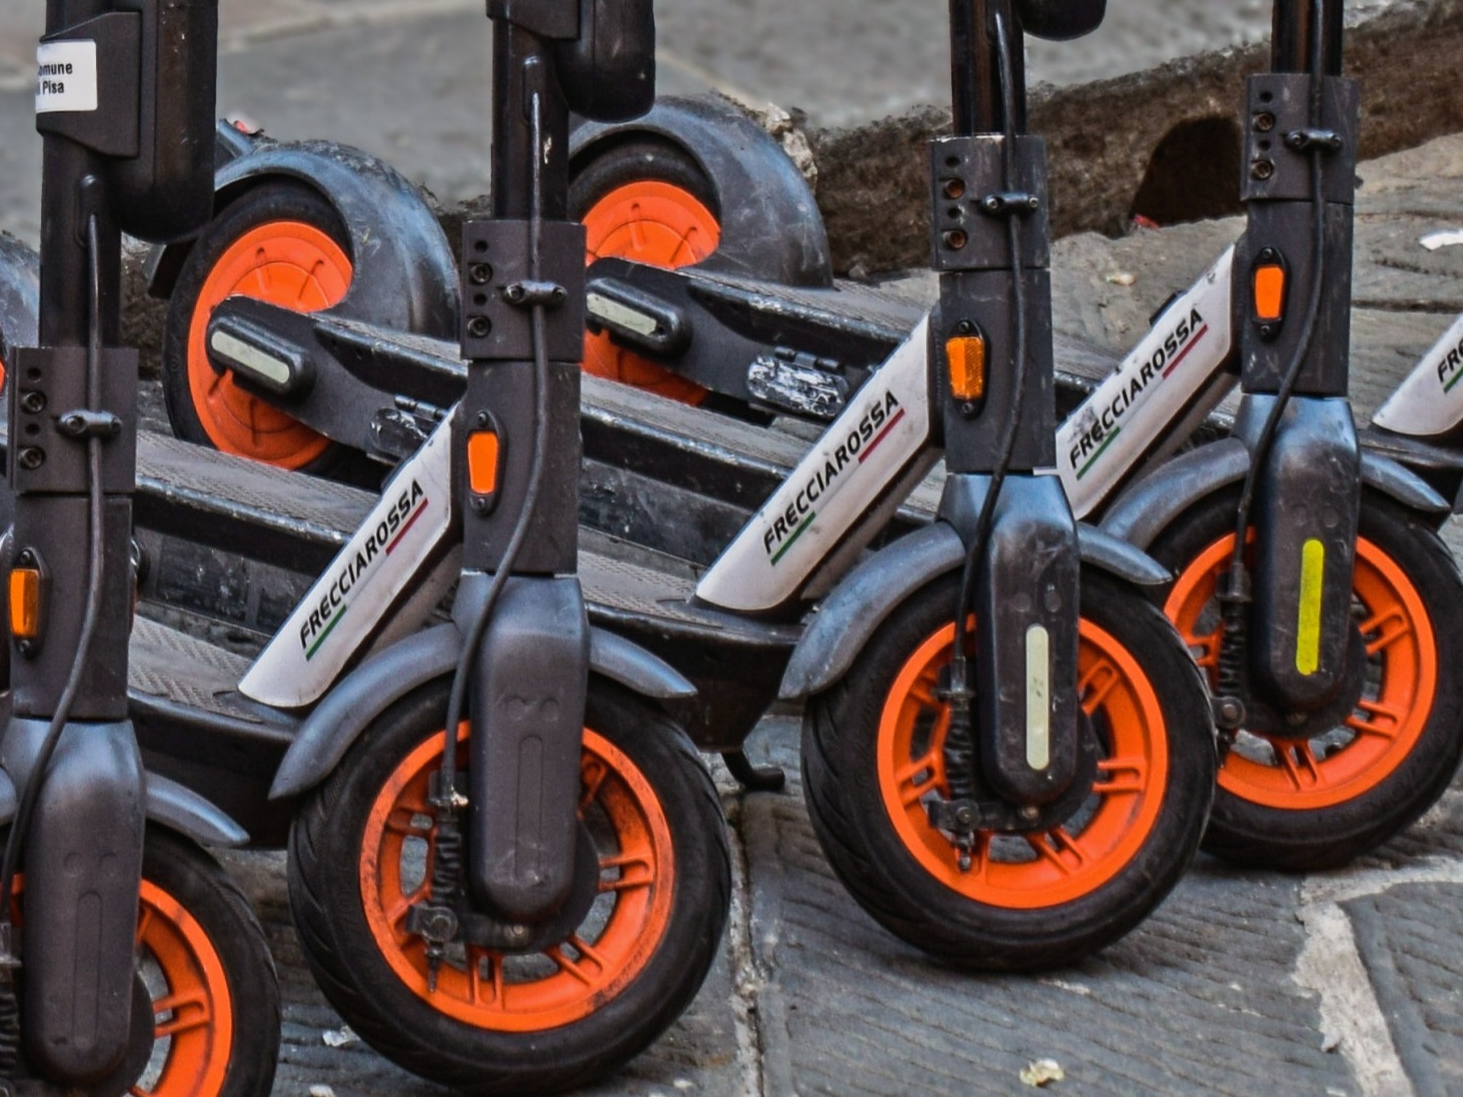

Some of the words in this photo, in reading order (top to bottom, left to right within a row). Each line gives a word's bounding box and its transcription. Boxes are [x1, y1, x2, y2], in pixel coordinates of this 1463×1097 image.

[37, 62, 74, 77] omune
[42, 79, 65, 95] Pisa
[1069, 308, 1204, 470] FRECCIAROSSA
[762, 390, 901, 556] FRECCIAROSSA
[299, 480, 425, 650] FRECCIAROSSA
